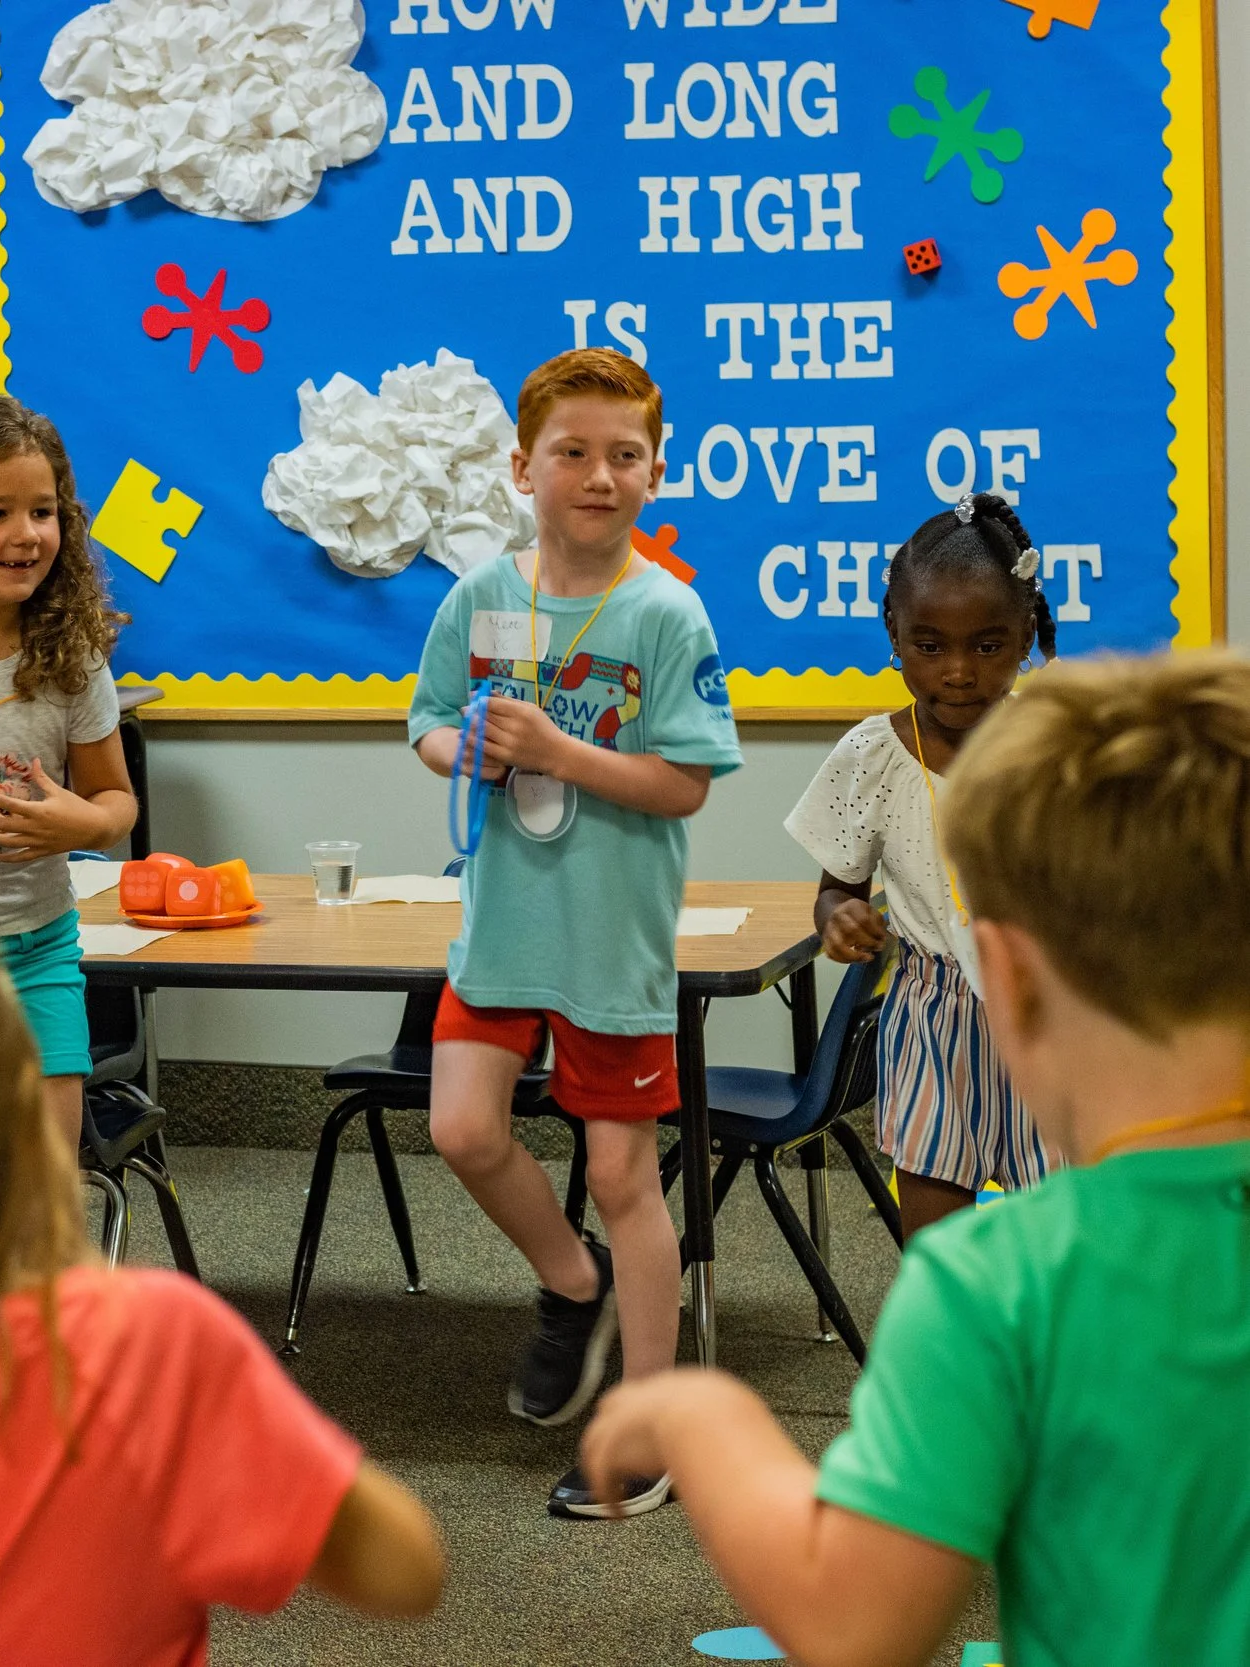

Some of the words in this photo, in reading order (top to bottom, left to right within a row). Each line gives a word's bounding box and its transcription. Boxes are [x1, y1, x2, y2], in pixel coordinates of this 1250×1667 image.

[389, 63, 573, 144] AND
[624, 60, 838, 140] LONG
[391, 175, 573, 255] AND
[639, 172, 864, 254] HIGH
[563, 299, 648, 369] IS
[705, 300, 894, 380] THE
[658, 423, 878, 504] LOVE
[926, 428, 1041, 506] OF
